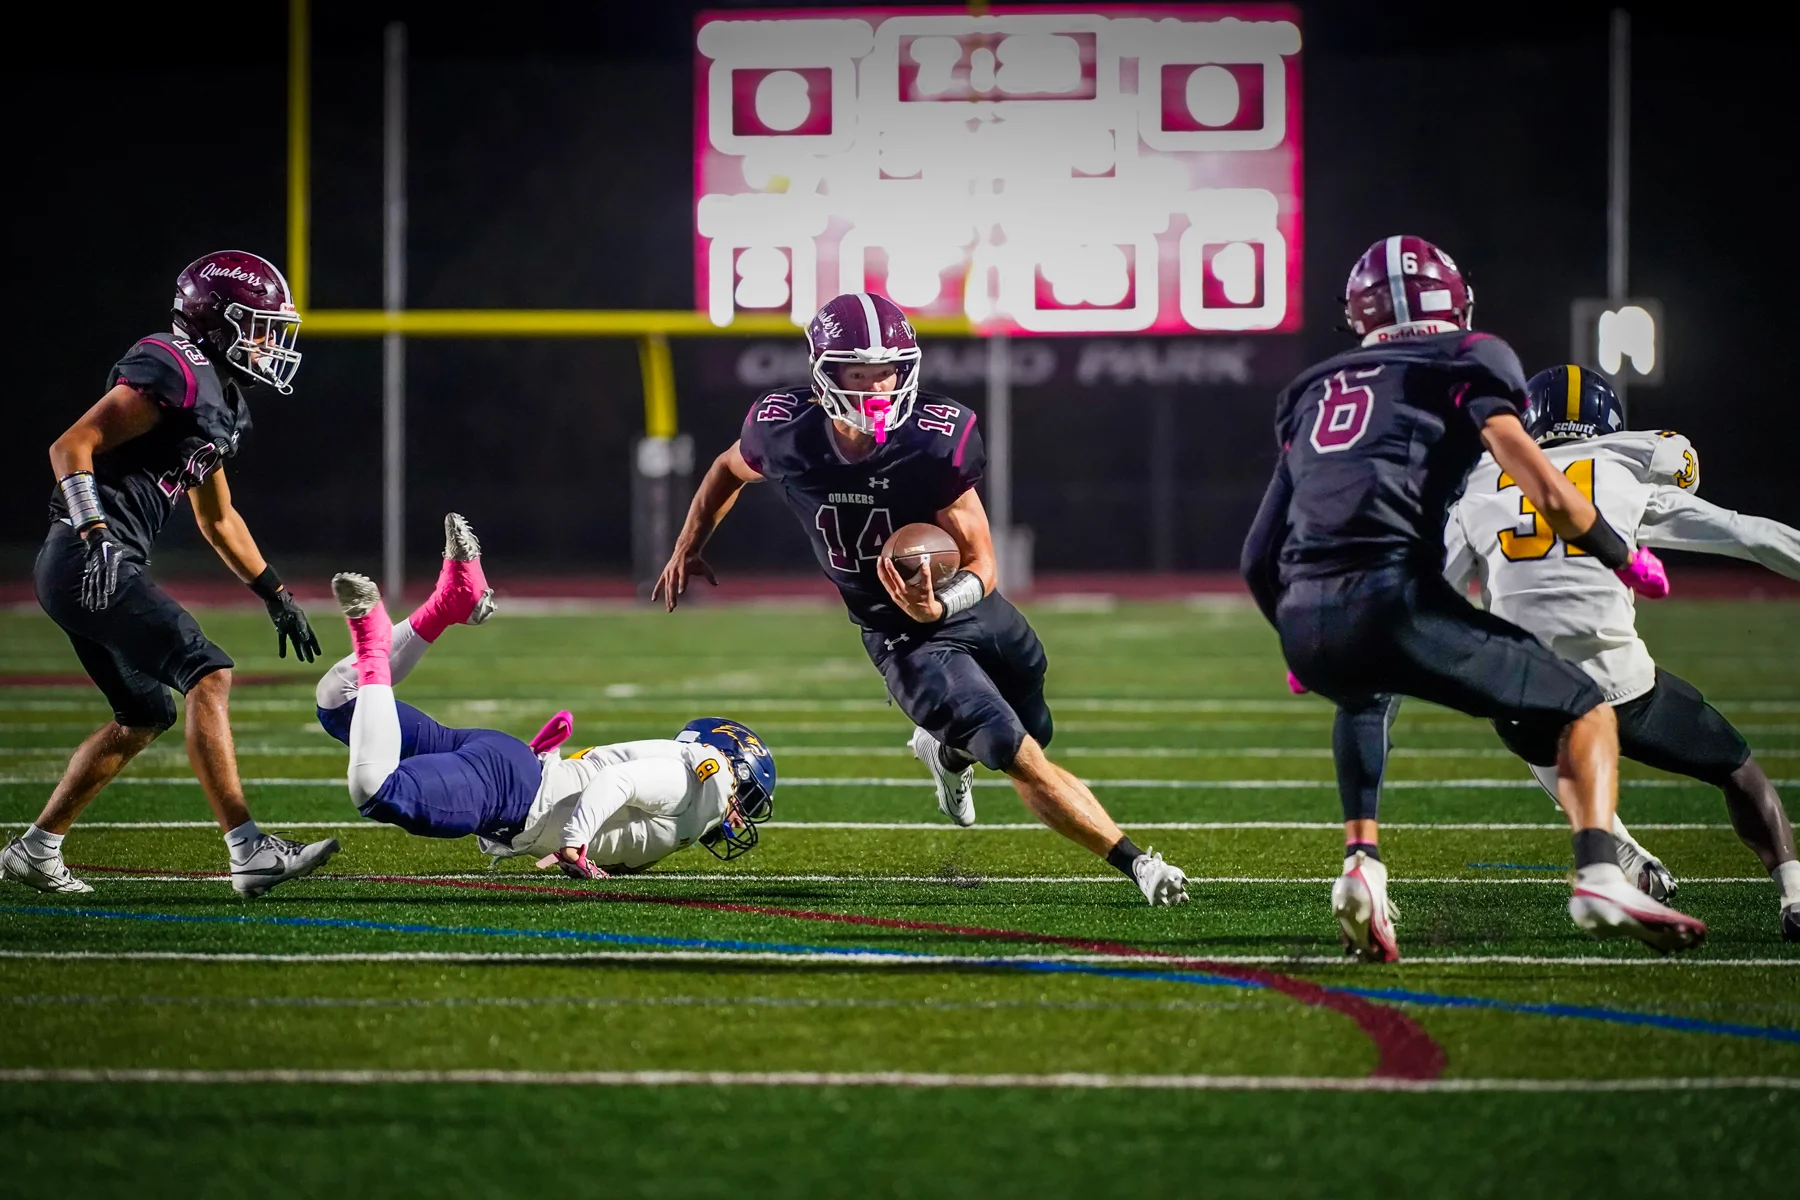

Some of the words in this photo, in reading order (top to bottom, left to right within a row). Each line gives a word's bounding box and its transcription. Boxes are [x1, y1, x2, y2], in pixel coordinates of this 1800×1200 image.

[199, 262, 261, 287] Quakers
[1402, 252, 1418, 275] 6
[735, 343, 1057, 384] OARD
[757, 393, 799, 422] 14
[917, 404, 960, 437] 14
[1309, 364, 1385, 454] 6
[1553, 420, 1598, 435] schutt
[828, 492, 875, 505] QUAKERS
[1497, 458, 1596, 562] 31
[815, 504, 894, 573] 14
